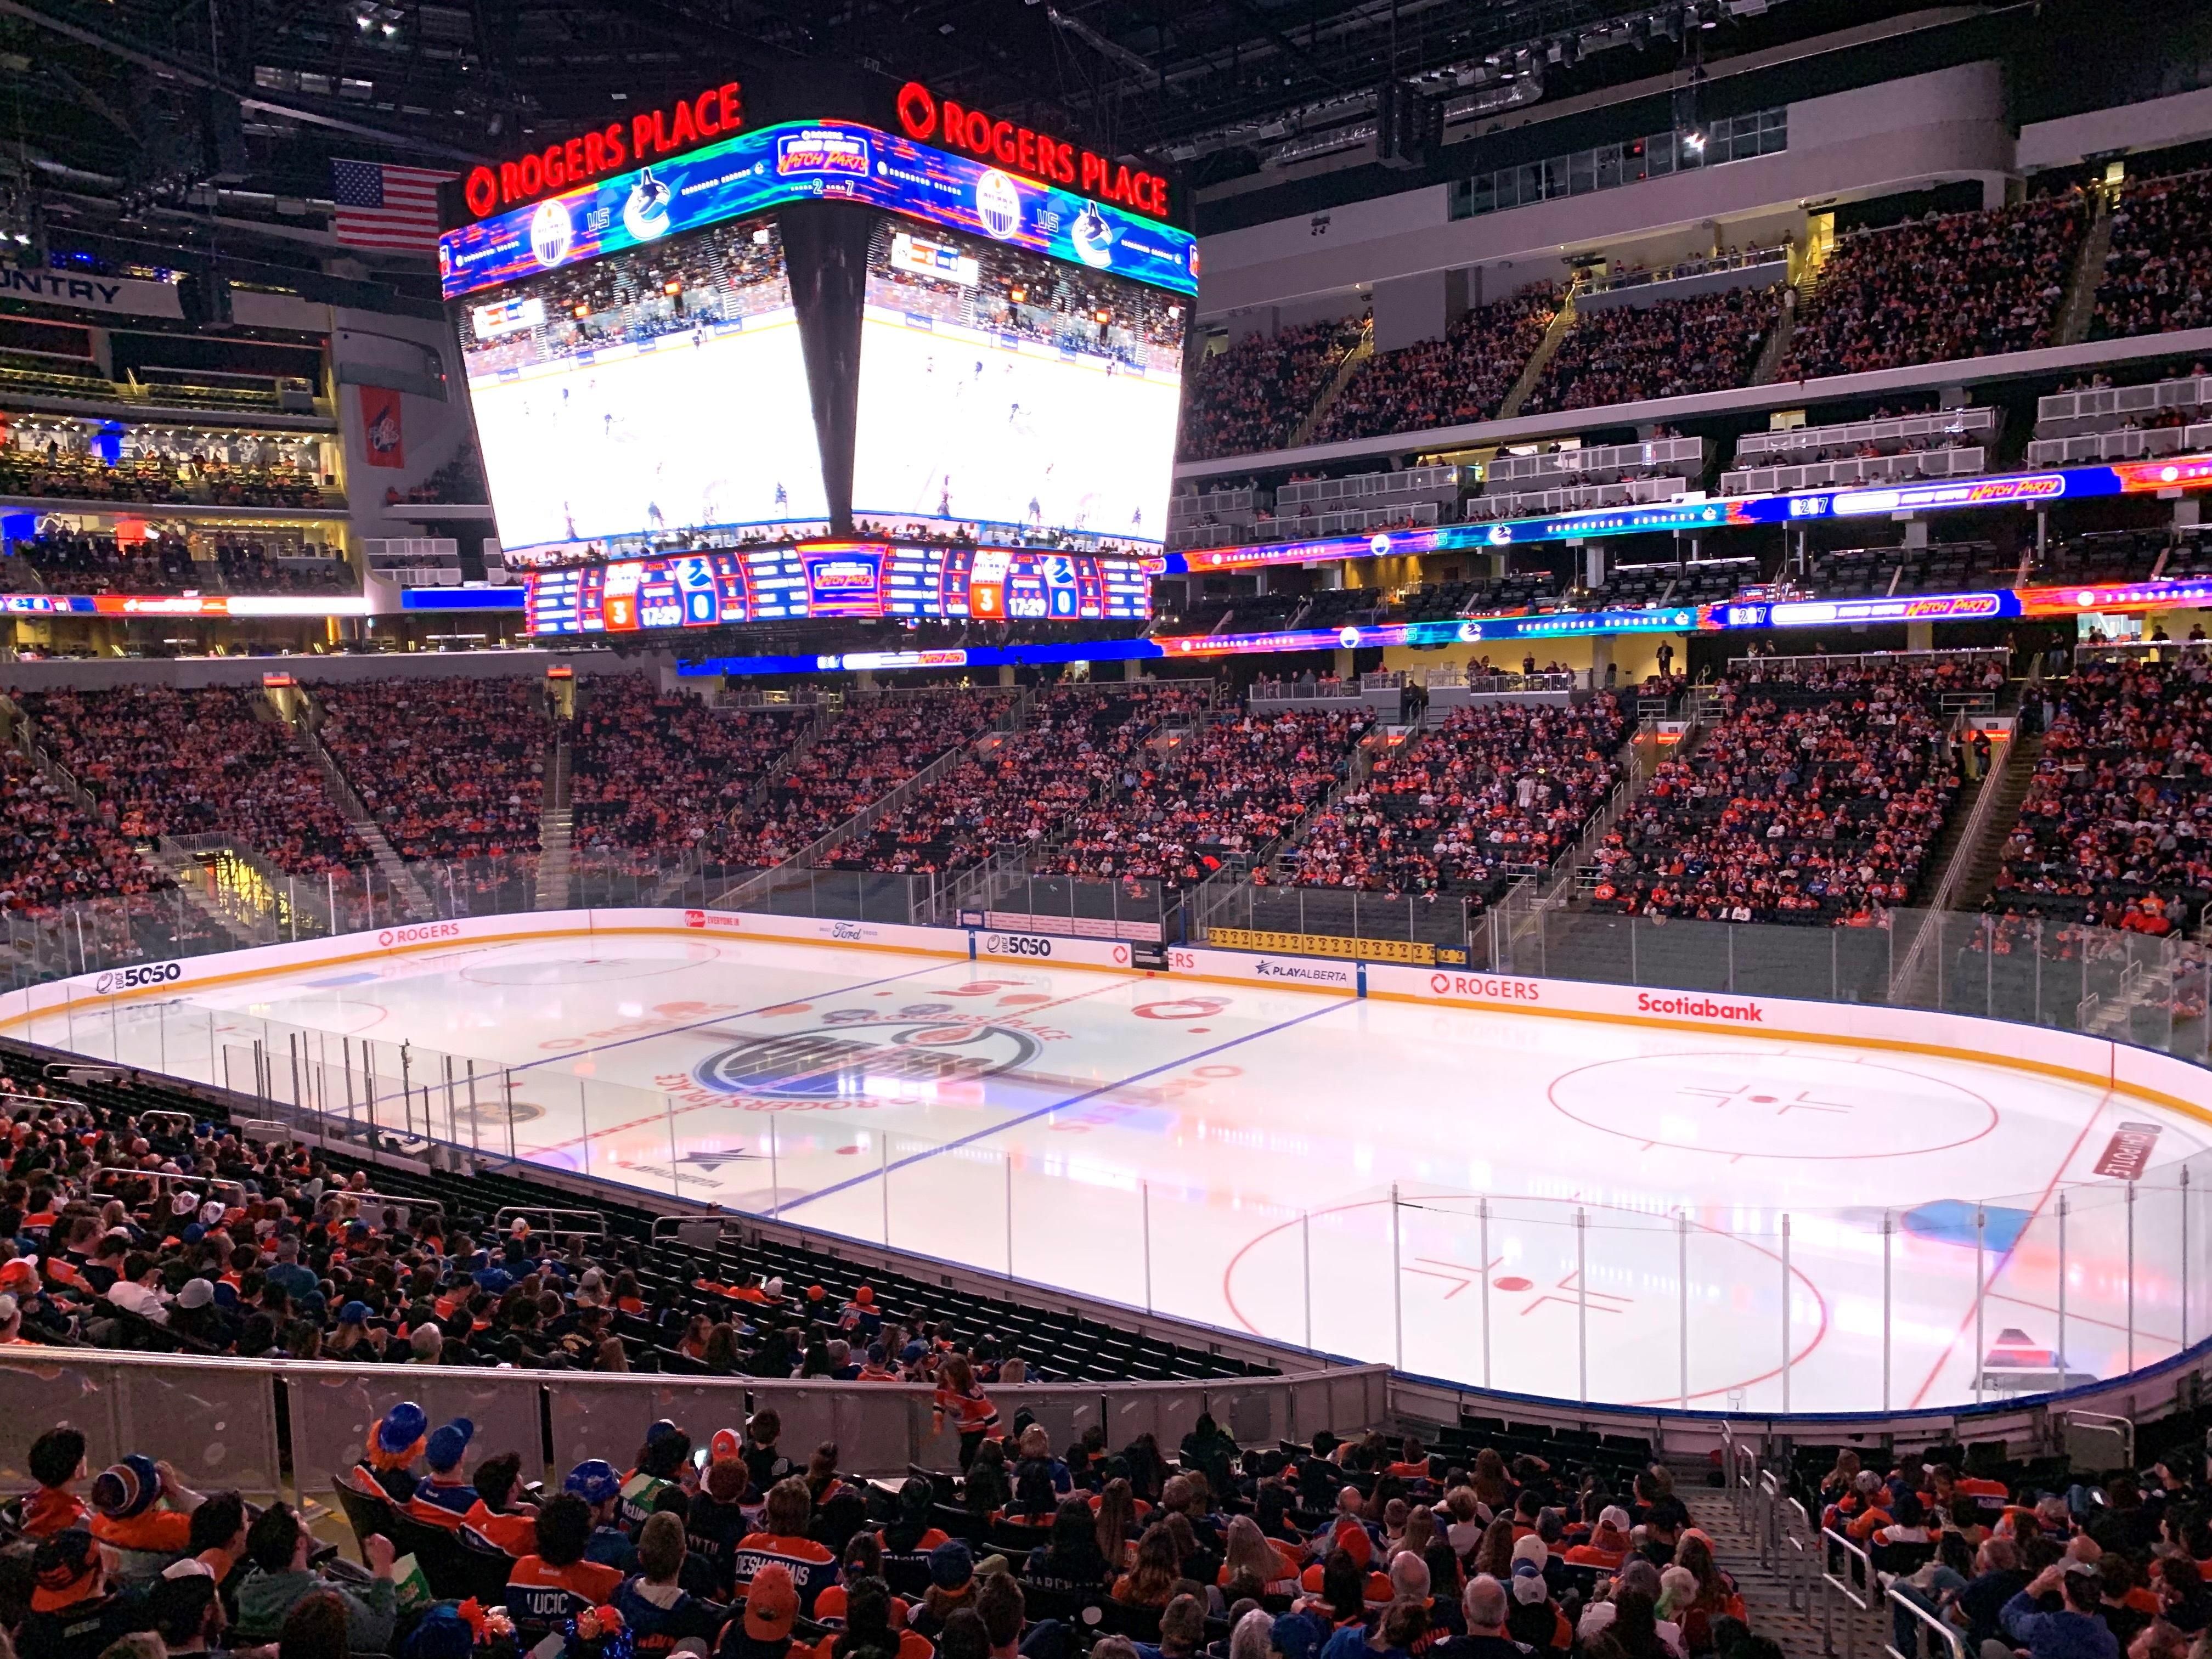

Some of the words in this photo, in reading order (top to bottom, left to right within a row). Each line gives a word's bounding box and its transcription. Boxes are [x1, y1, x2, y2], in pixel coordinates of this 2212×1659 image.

[501, 123, 624, 204] ROGERS
[633, 82, 742, 159] PLACE
[811, 131, 843, 140] ROGERS
[777, 151, 823, 172] WATCH
[824, 151, 869, 171] PARTY
[944, 101, 1075, 184] ROGERS
[1082, 151, 1168, 217] PLACE
[587, 207, 610, 232] VS
[1037, 208, 1058, 233] VS
[1970, 484, 2014, 500] WATCH
[2014, 481, 2058, 497] PARTY
[1426, 533, 1447, 546] VS
[815, 576, 844, 586] WATCH
[844, 575, 874, 586] PARTY
[693, 594, 709, 619] 0
[980, 589, 992, 611] 3
[1058, 591, 1070, 613] 0
[1905, 601, 1949, 616] WATCH
[1949, 599, 1994, 614] PARTY
[613, 601, 626, 624] 3
[1396, 628, 1417, 641] VS
[397, 923, 460, 943] ROGERS
[833, 922, 862, 940] Ford
[1009, 936, 1051, 956] 5050
[1168, 952, 1194, 968] ERS
[125, 963, 181, 987] 5050
[1456, 978, 1539, 1000] ROGERS
[1638, 994, 1763, 1022] Scotiabank
[862, 1014, 990, 1022] ROGERS
[1003, 1019, 1074, 1041] PLACE
[2104, 1133, 2148, 1176] CHIPOTLE
[736, 1555, 810, 1585] DESHAIS
